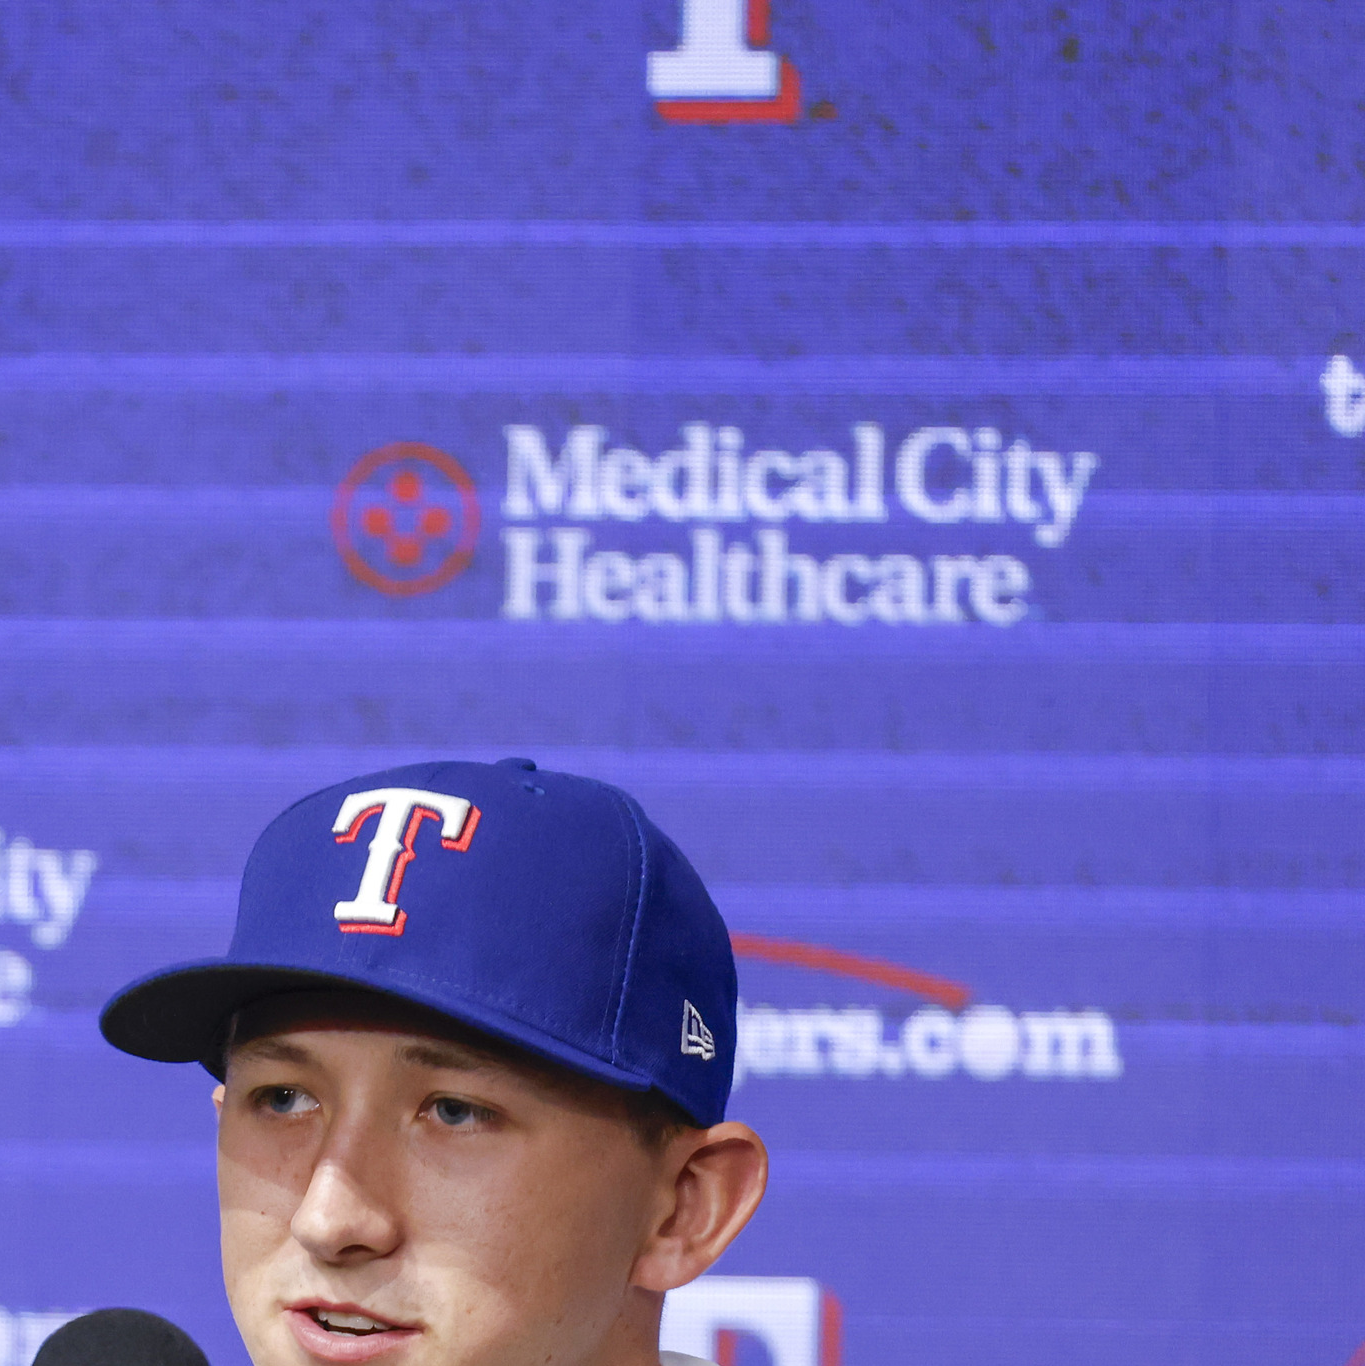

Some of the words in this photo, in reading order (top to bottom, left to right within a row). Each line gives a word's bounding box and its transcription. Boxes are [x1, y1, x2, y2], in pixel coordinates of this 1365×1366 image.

[502, 422, 886, 522] Medical
[896, 427, 1097, 547] City
[502, 528, 1031, 627] Healthcare
[331, 787, 482, 937] T
